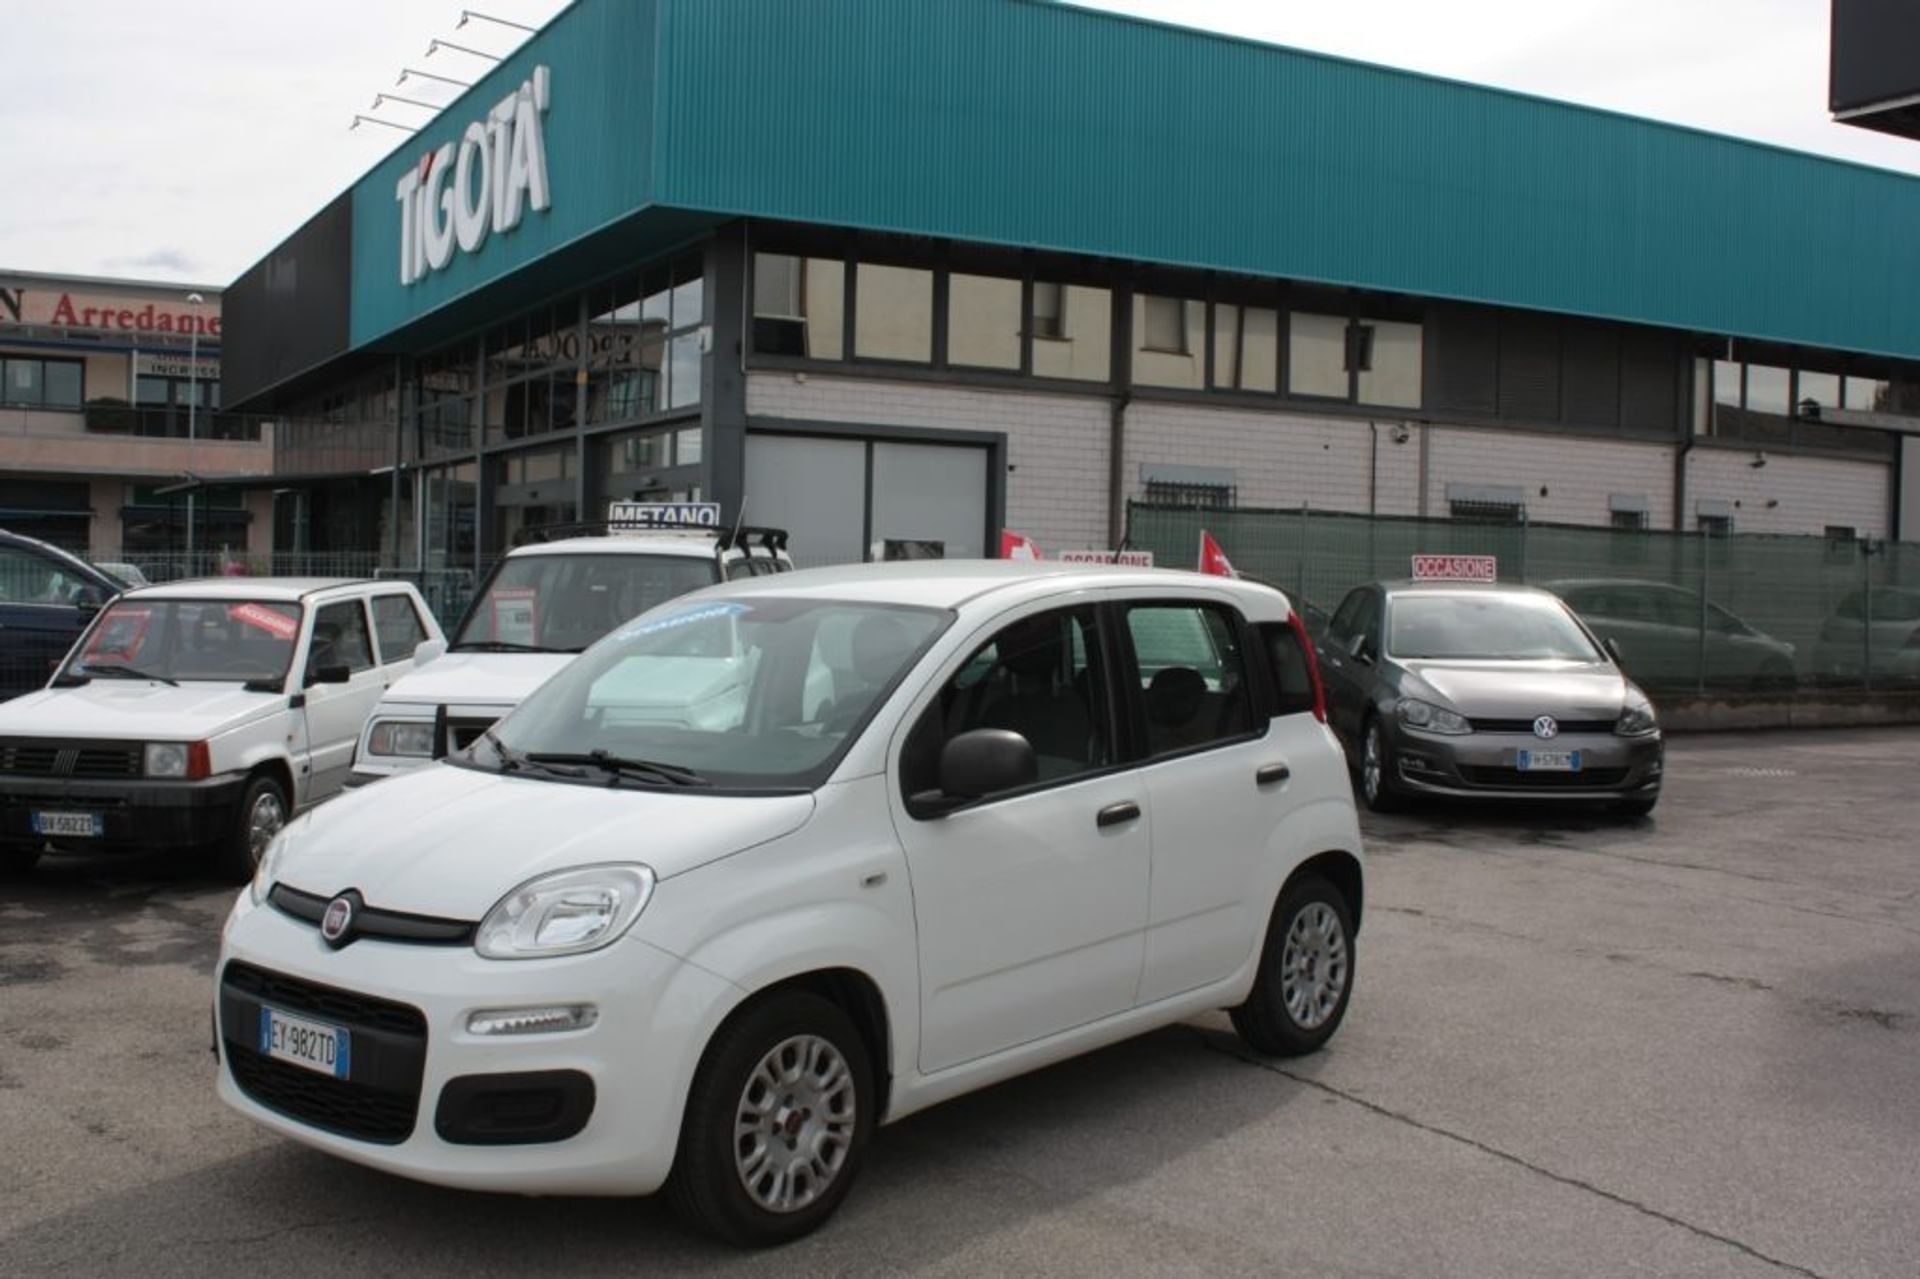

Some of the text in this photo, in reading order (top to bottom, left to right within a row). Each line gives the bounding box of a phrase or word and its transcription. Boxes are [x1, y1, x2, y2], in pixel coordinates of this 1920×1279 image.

[52, 293, 221, 335] Arredame
[614, 506, 715, 529] METANO
[1416, 558, 1493, 577] OCCASIONE
